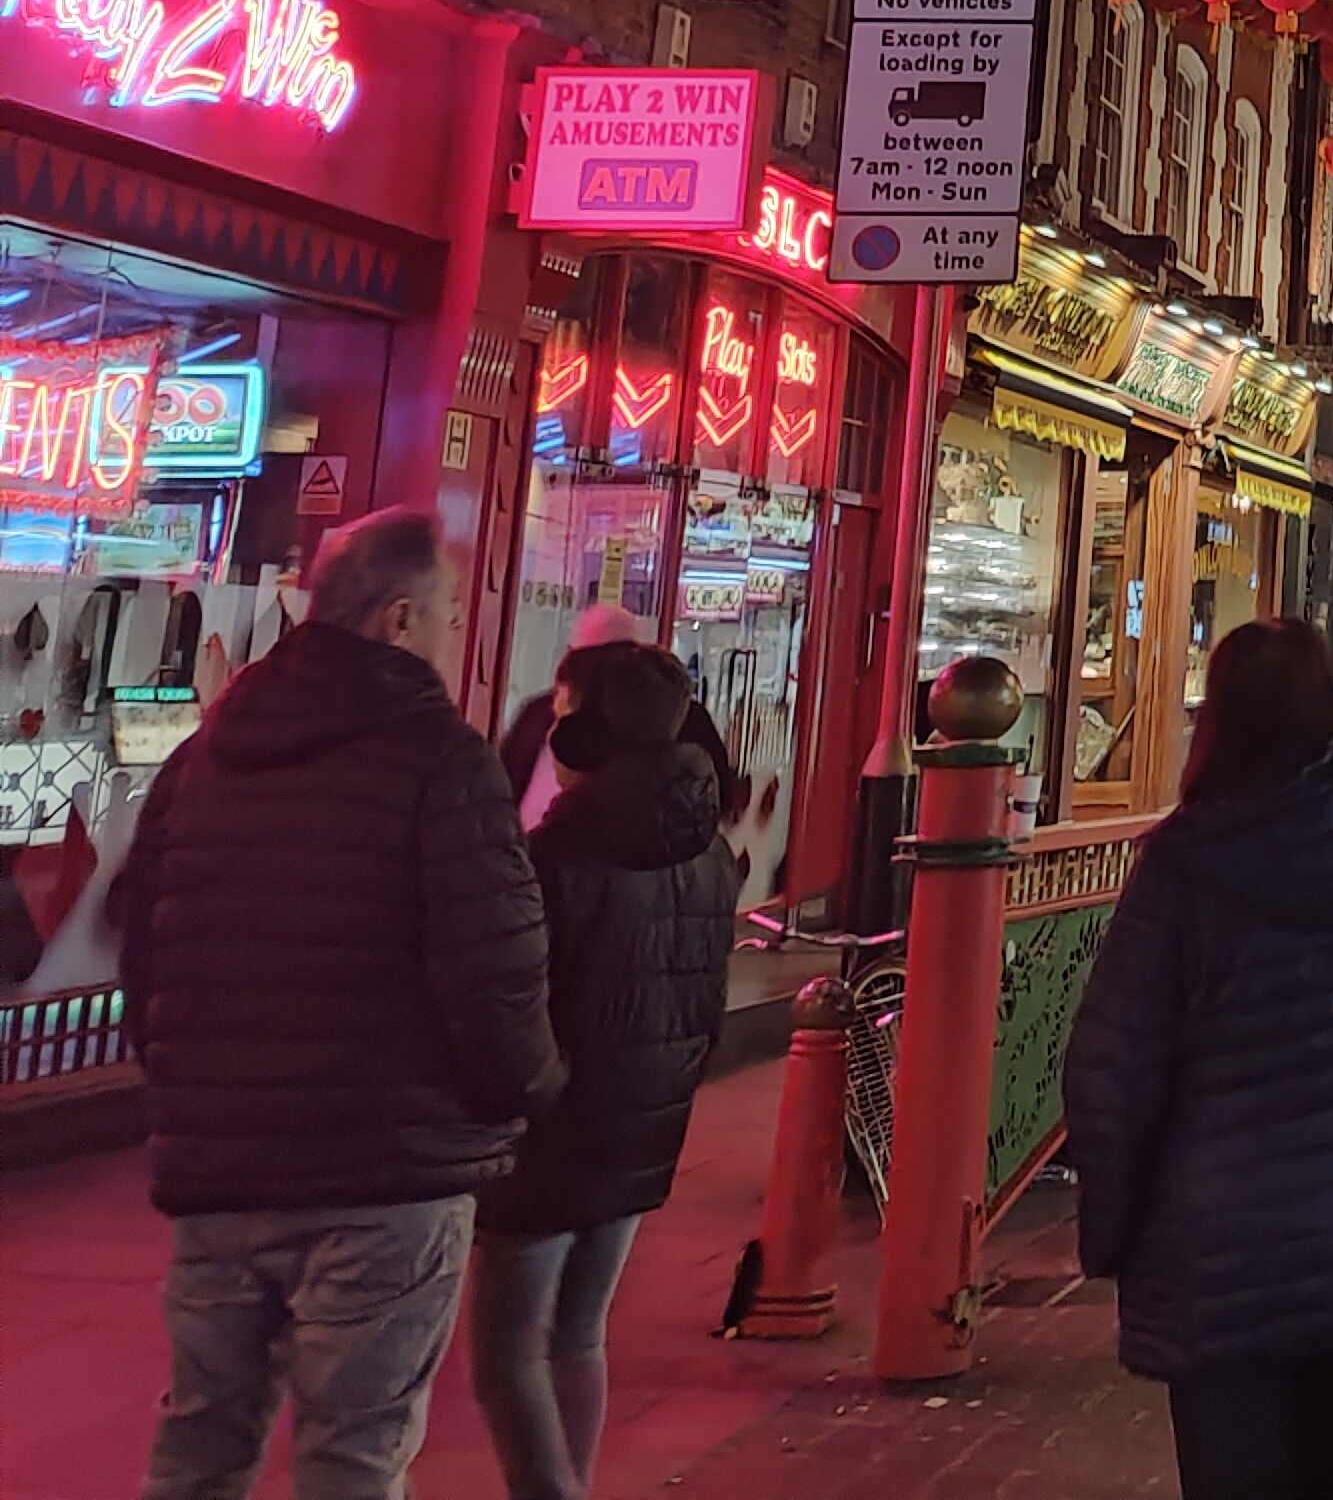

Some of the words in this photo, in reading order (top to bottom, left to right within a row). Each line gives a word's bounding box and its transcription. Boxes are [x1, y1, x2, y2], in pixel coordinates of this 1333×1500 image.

[881, 29, 961, 50] Except
[970, 29, 1003, 48] for
[879, 53, 964, 76] loading
[973, 54, 1000, 76] by
[552, 82, 640, 115] PLAY
[646, 89, 665, 114] 2
[674, 84, 745, 115] WIN
[549, 119, 740, 147] AMUSEMENTS
[883, 132, 984, 151] between
[850, 157, 901, 176] 7am
[923, 157, 948, 176] 12
[956, 160, 1013, 176] noon
[581, 166, 692, 204] ATM
[871, 181, 921, 201] Mon
[941, 181, 988, 201] Sun
[922, 226, 949, 245] At
[957, 229, 999, 248] any
[934, 251, 985, 270] time
[701, 306, 754, 399] Play
[777, 331, 817, 386] Slots
